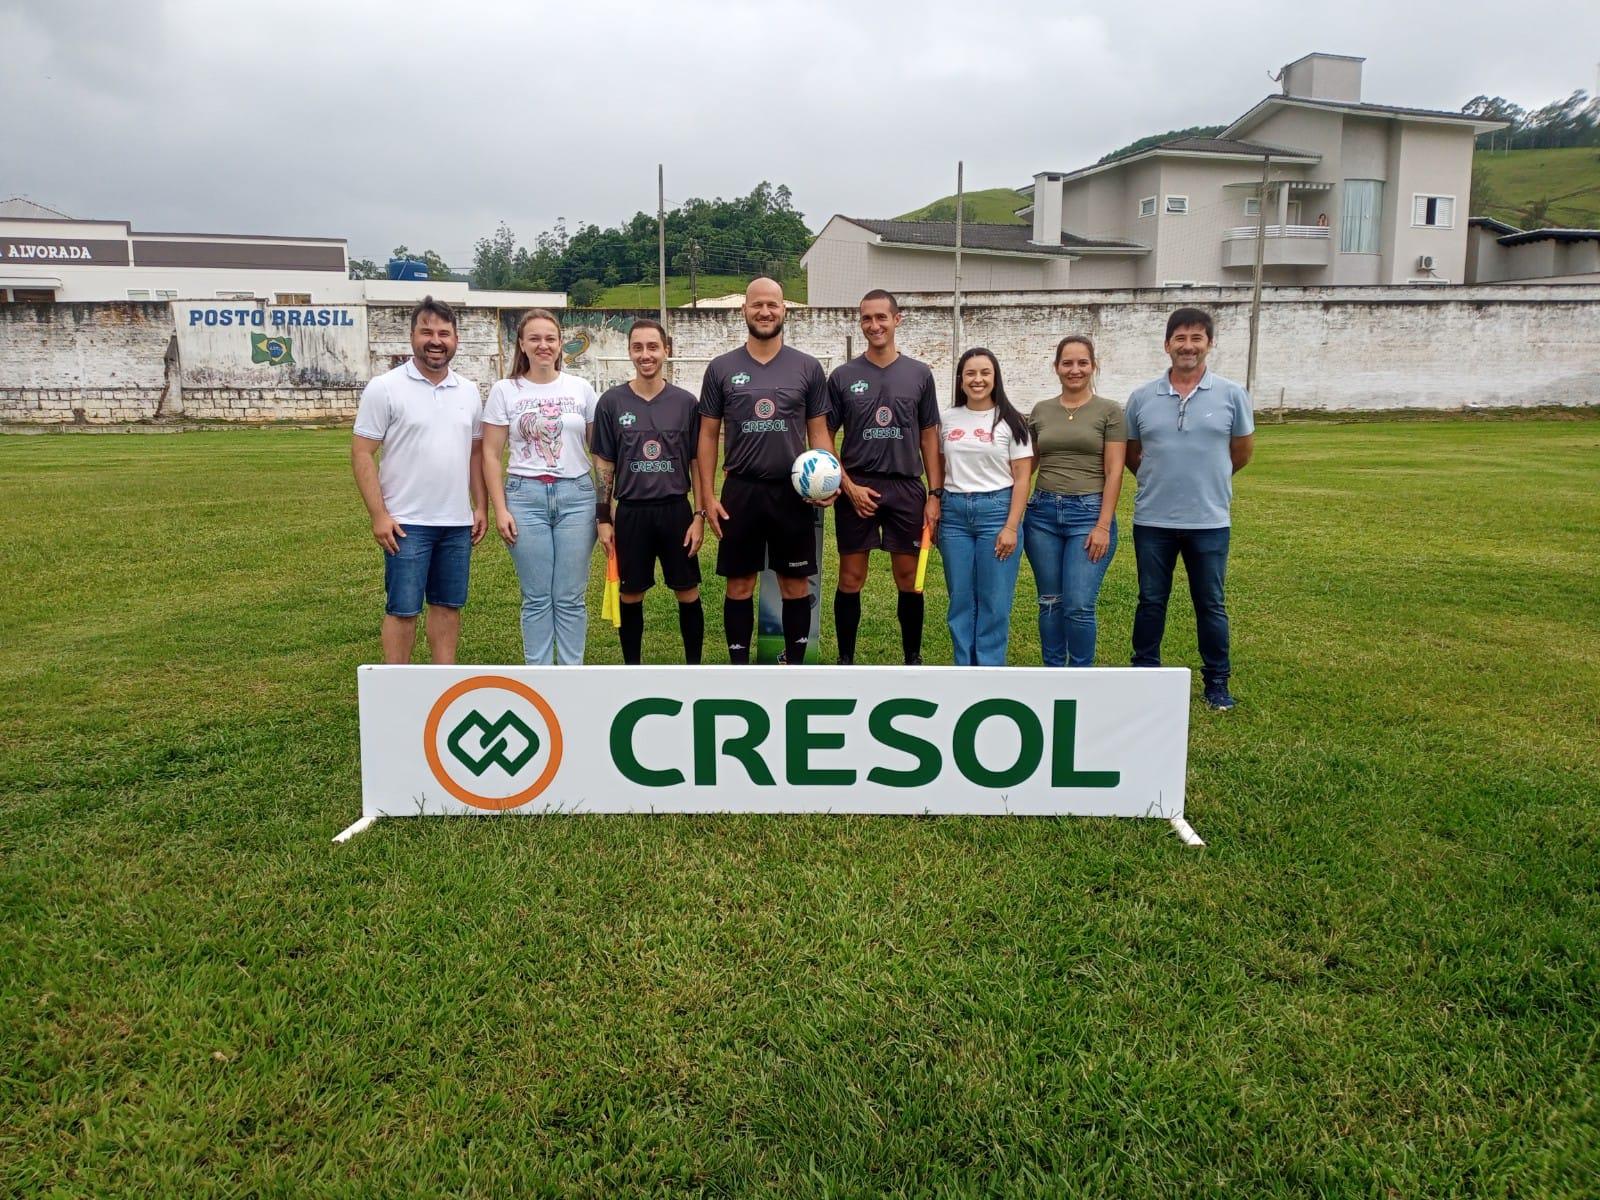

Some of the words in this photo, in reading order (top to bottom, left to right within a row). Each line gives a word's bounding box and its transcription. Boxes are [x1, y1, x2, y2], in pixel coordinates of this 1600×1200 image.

[8, 244, 92, 259] ALVORADA
[189, 309, 265, 326] POSTO
[271, 309, 354, 327] BRASIL
[741, 419, 788, 433] CRESOL
[863, 427, 904, 440] CRESOL
[630, 460, 675, 473] CRESOL
[609, 697, 1121, 788] CRESOL
